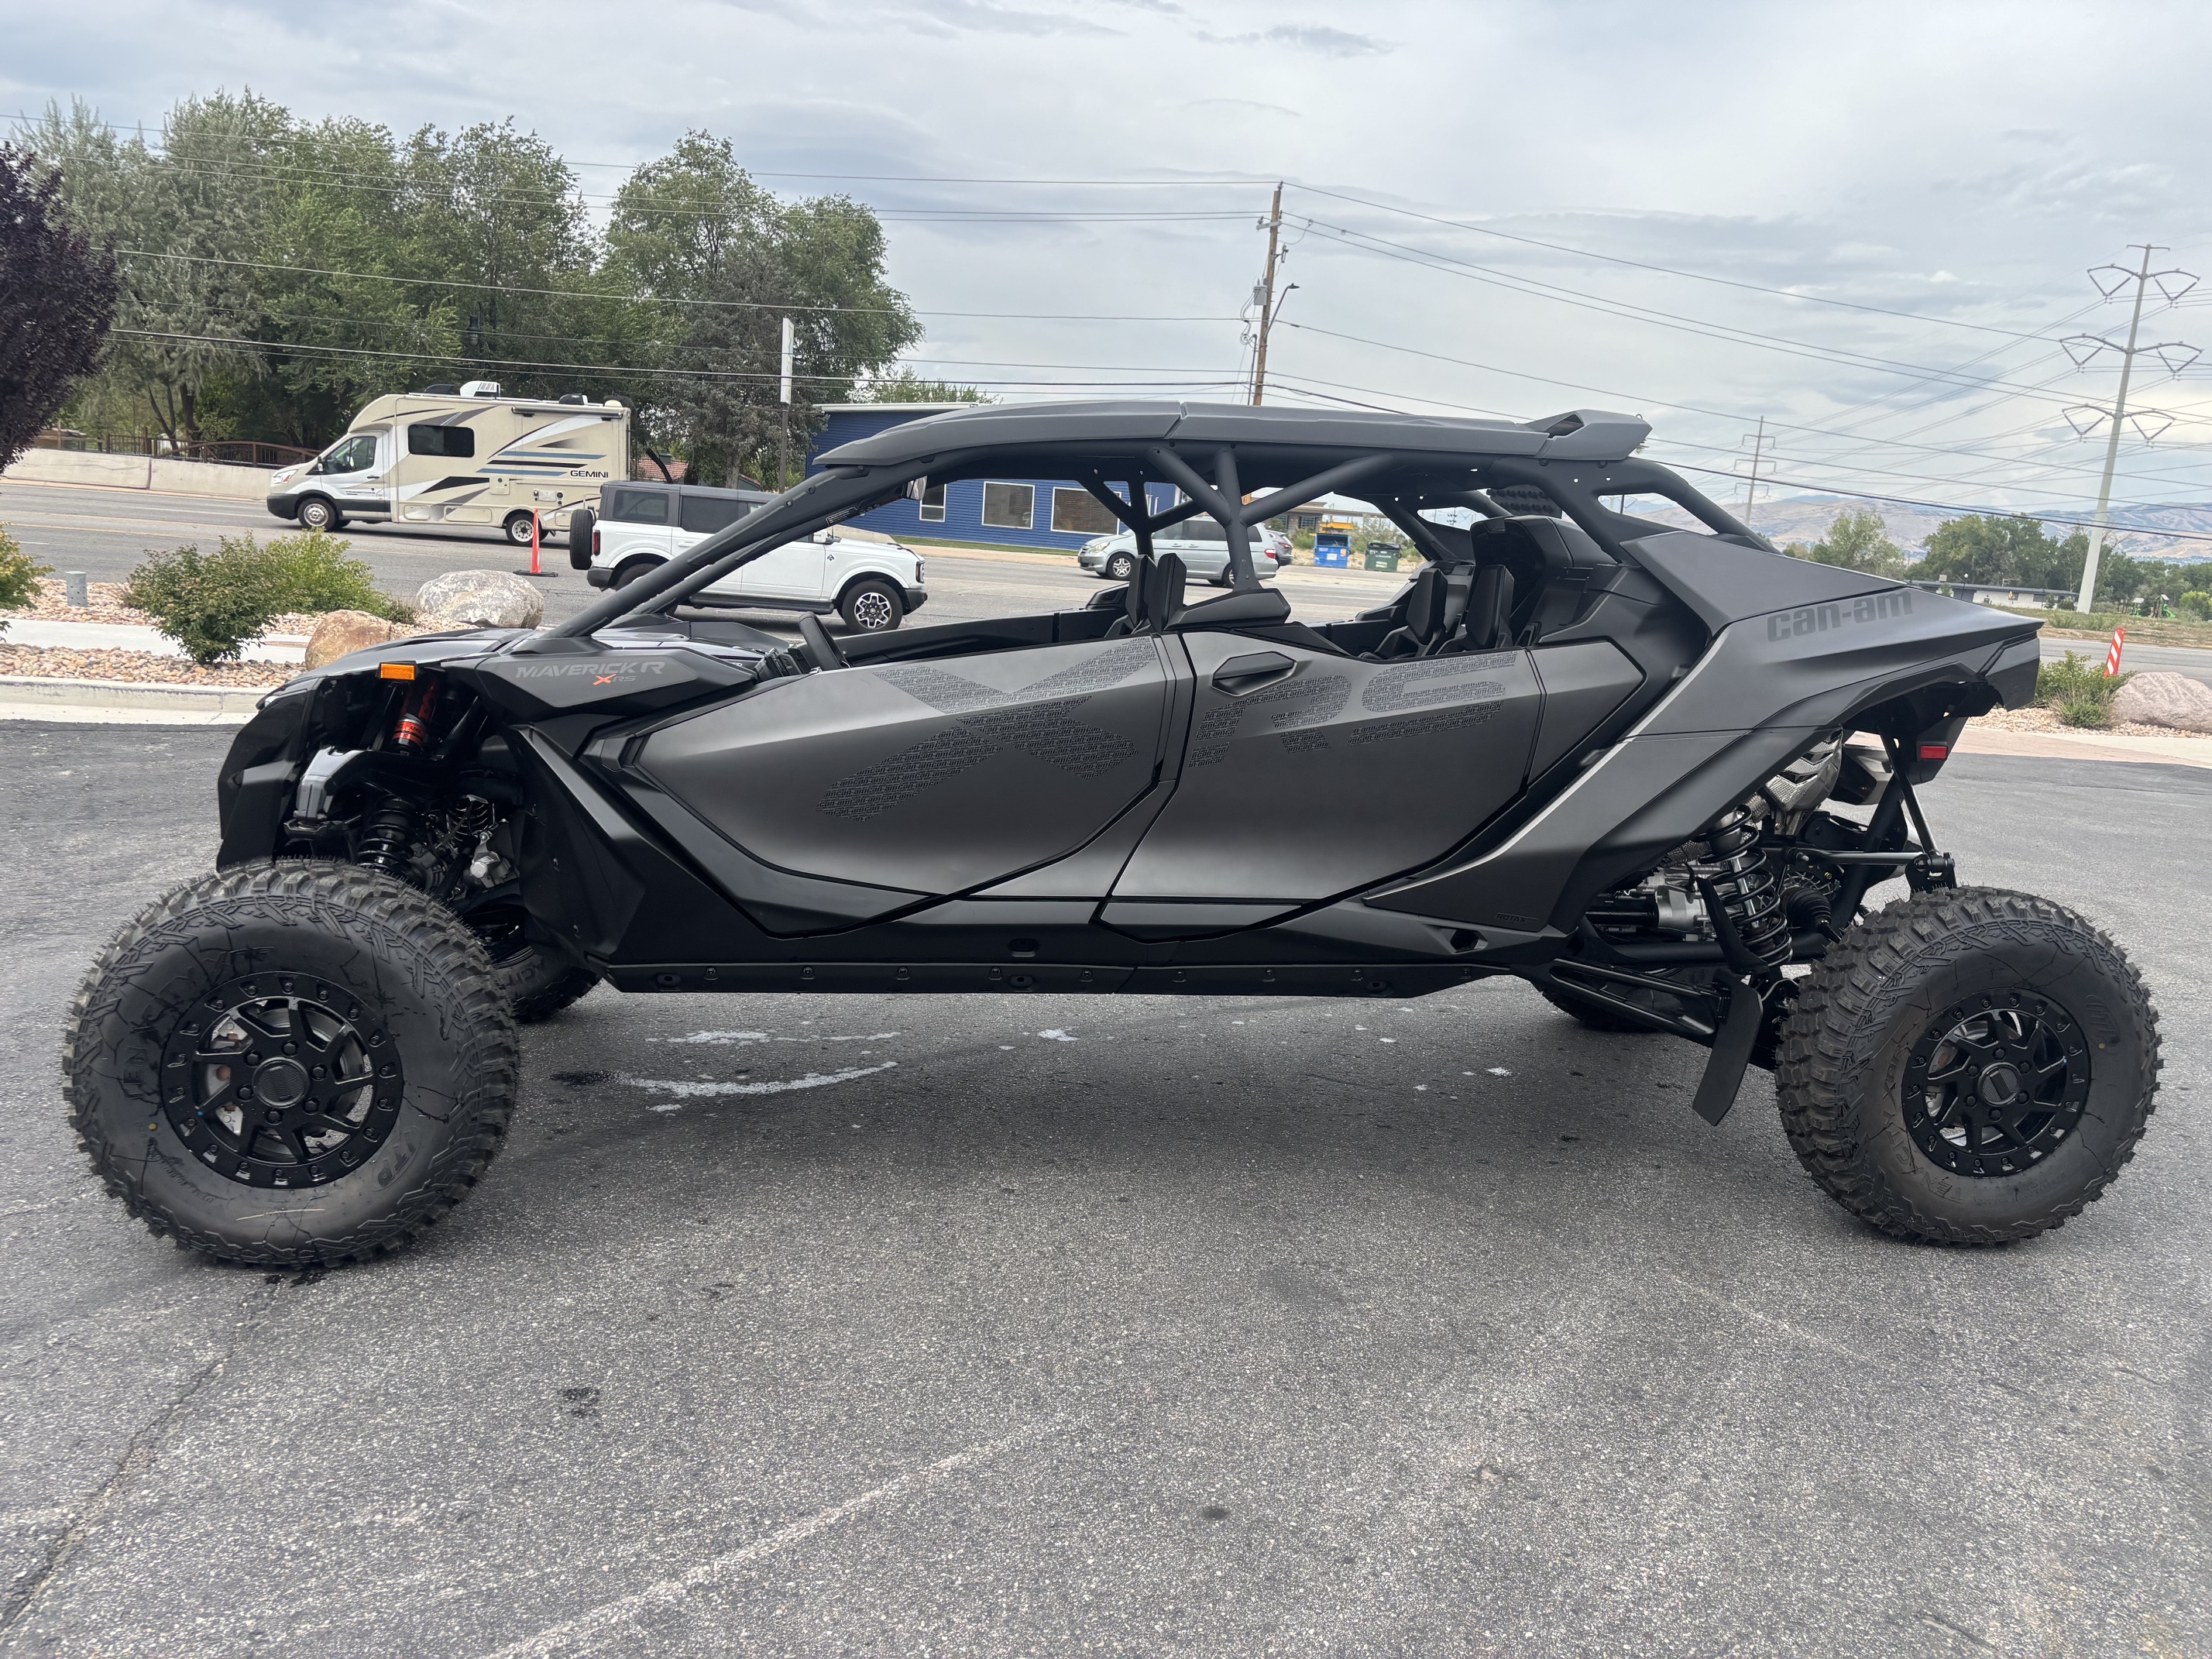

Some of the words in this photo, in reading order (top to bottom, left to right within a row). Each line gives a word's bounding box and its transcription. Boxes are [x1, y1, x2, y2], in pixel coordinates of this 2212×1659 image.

[570, 470, 609, 479] GEMINI
[1767, 592, 1913, 642] can-am
[516, 662, 637, 678] MAVERICK
[641, 661, 665, 675] R
[1496, 913, 1527, 923] ROTAX
